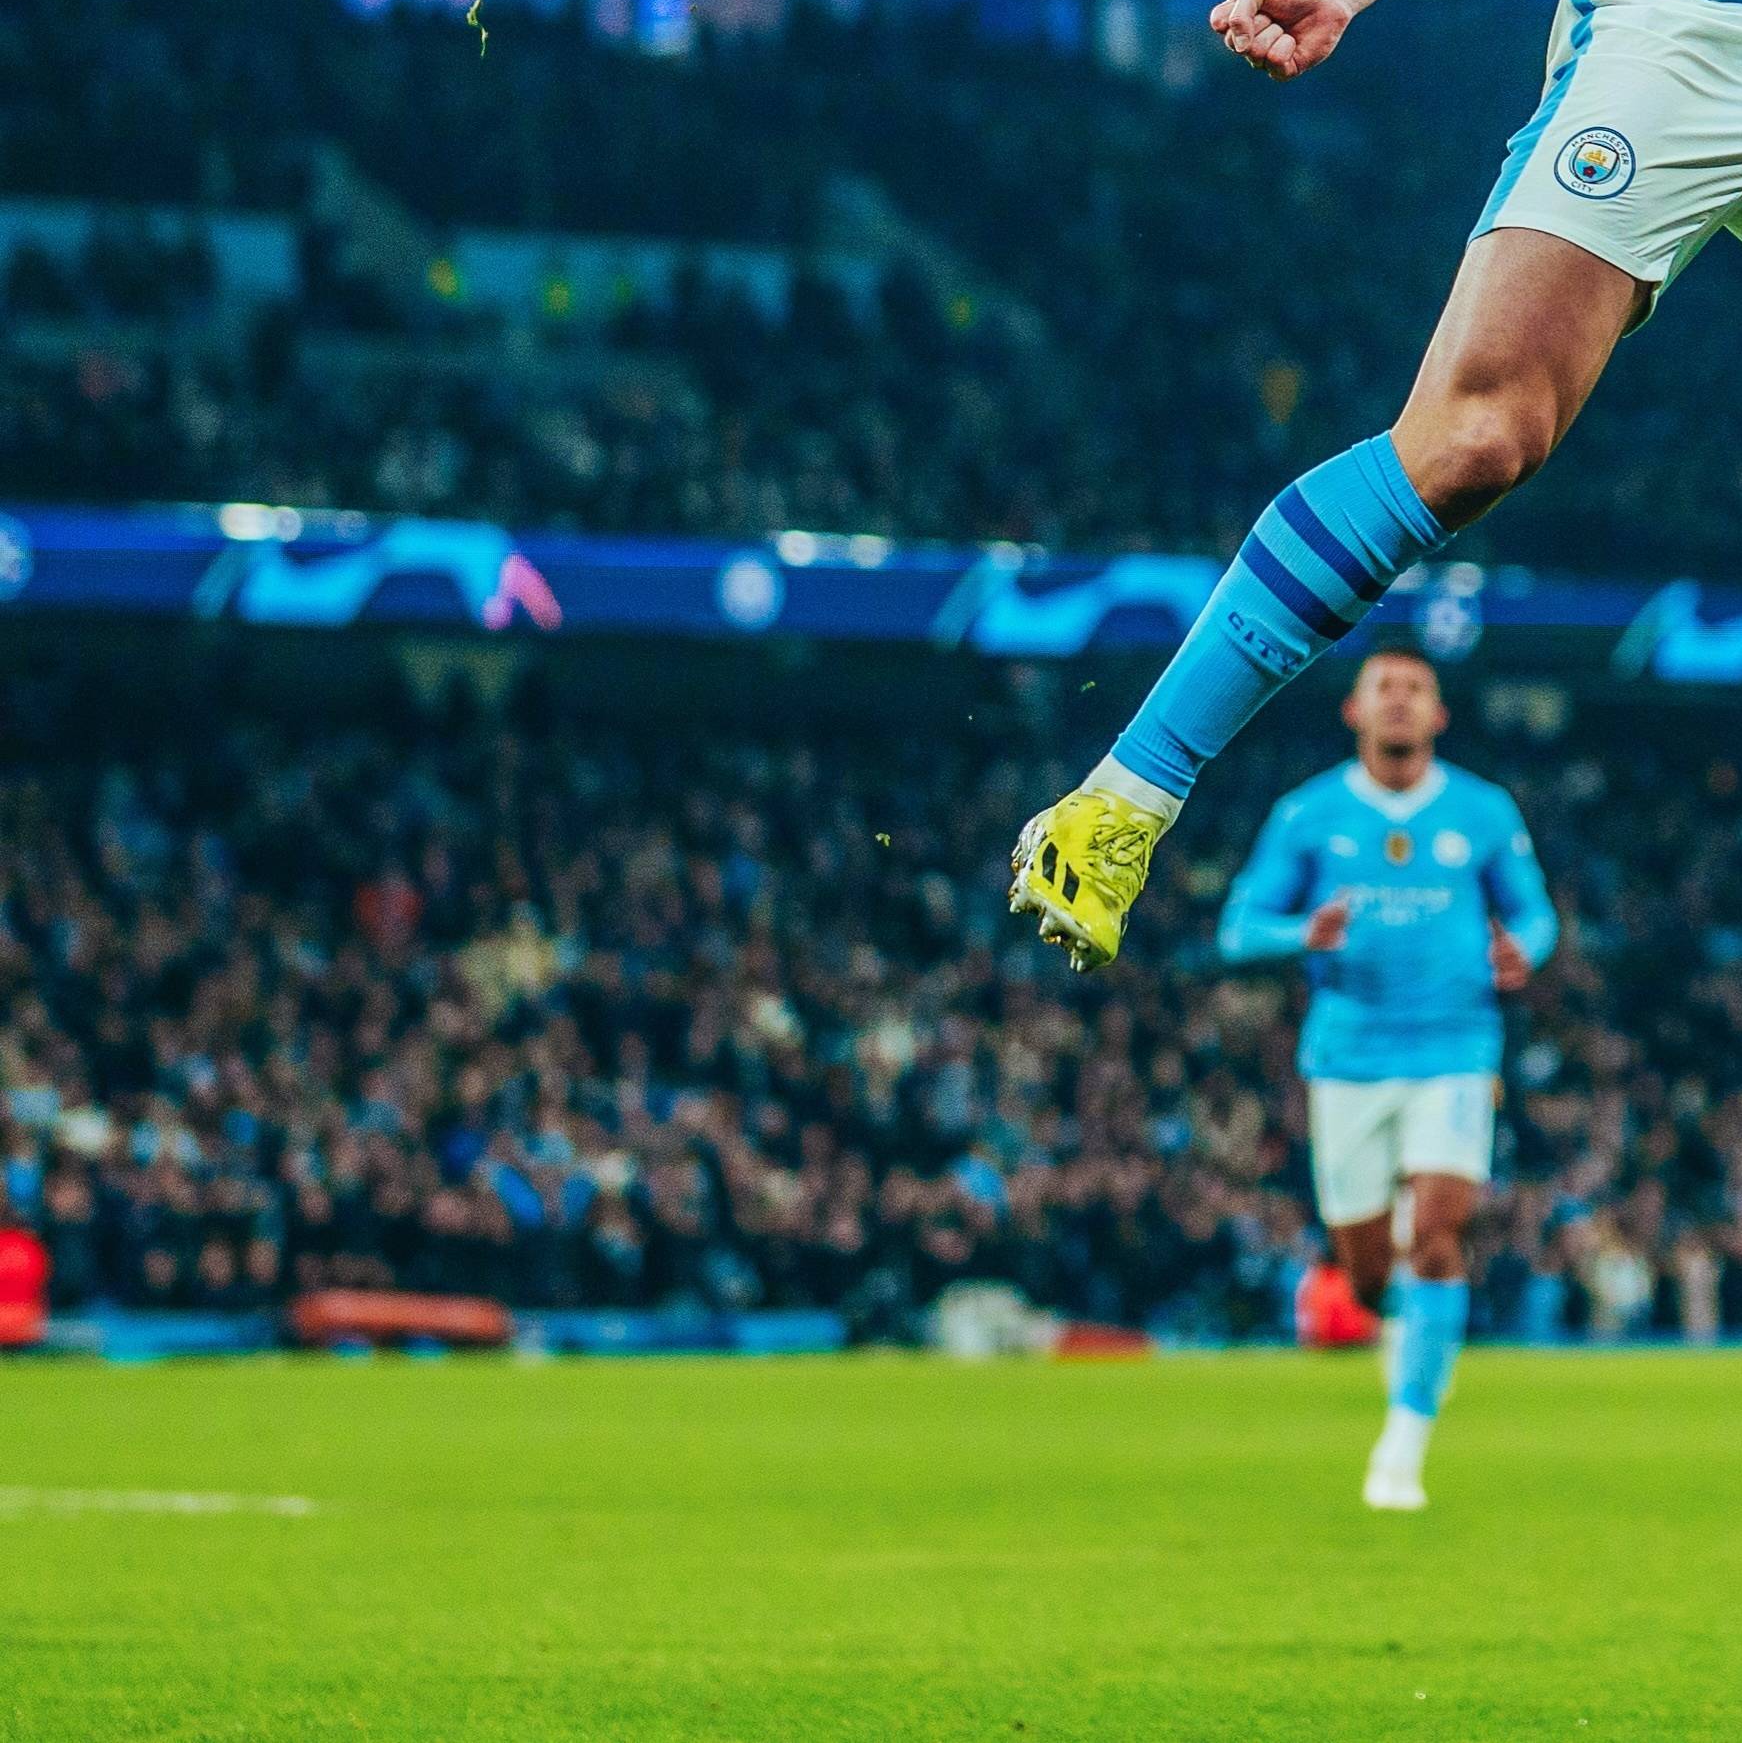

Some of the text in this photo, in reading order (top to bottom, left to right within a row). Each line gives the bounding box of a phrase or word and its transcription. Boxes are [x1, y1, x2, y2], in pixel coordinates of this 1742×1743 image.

[1571, 132, 1630, 166] MANCHESTER
[1571, 180, 1594, 193] CITY
[1227, 611, 1303, 674] CITY
